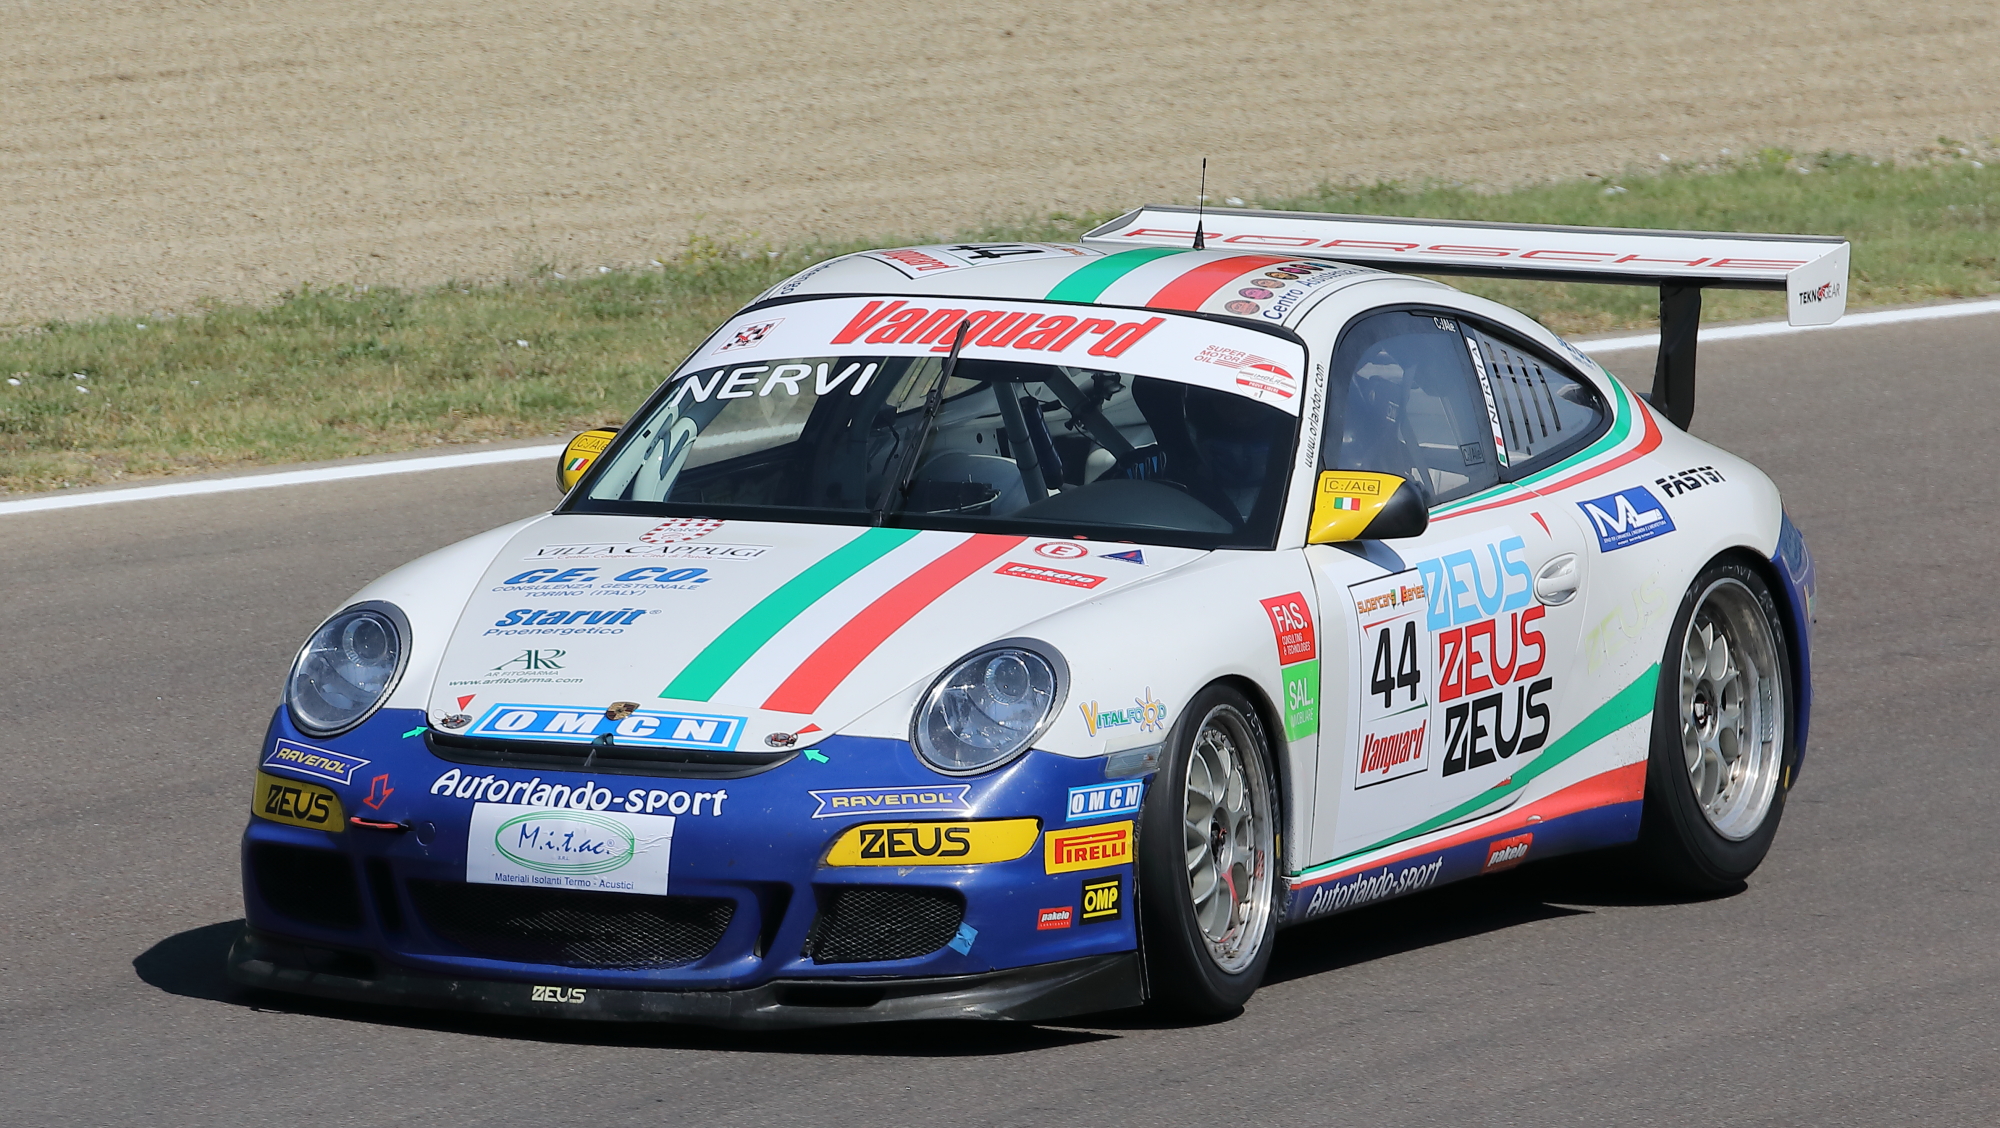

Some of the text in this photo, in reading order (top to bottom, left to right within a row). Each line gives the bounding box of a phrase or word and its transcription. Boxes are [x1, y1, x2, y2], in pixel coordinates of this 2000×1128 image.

[1122, 227, 1809, 270] PORSCHE
[1262, 288, 1305, 320] Centro
[829, 300, 1167, 359] Vanguard
[1193, 355, 1213, 364] OIL
[1200, 350, 1241, 363] MOTOR
[1206, 344, 1246, 358] SUPER
[670, 362, 878, 408] NERVI
[1475, 362, 1498, 425] NERVI
[1303, 362, 1325, 469] www.orlandor.com
[1328, 480, 1377, 492] C:/Ale
[536, 545, 768, 558] VILLA CAPPUGI
[1052, 545, 1073, 556] E
[491, 583, 700, 592] CONSULENZA GESTIONALE
[503, 566, 713, 585] GE. CO.
[1008, 565, 1096, 584] pakelo
[1415, 535, 1533, 632] ZEUS
[525, 590, 647, 598] TORINO (ITALY)
[495, 607, 648, 627] Starvit
[1271, 601, 1309, 633] FAS.
[482, 627, 625, 637] Proenergetico
[489, 649, 567, 671] AR
[1370, 620, 1421, 709] 44
[1438, 604, 1547, 703] ZEUS
[448, 677, 584, 686] www.arfitofarma.com
[1288, 677, 1314, 711] SAL.
[494, 710, 720, 742] OMCN
[1442, 676, 1553, 777] ZEUS
[1360, 718, 1427, 775] Vanguard
[276, 747, 345, 775] RAVENOL
[264, 784, 334, 824] ZEUS
[430, 768, 729, 817] Autorlando-sport
[832, 792, 953, 808] RAVENOL
[1071, 786, 1139, 813] OMCN
[860, 827, 971, 859] ZEUS
[1054, 829, 1127, 865] PIRELLI
[1487, 842, 1529, 867] pakelo
[494, 872, 530, 884] Materiali
[531, 875, 563, 887] Isolanti
[564, 876, 591, 888] Termo
[599, 879, 635, 891] Acustici
[1304, 855, 1445, 918] Autorlando-sport
[1084, 886, 1119, 912] OMP
[1041, 910, 1070, 923] pakelo
[531, 985, 586, 1004] ZEUS
